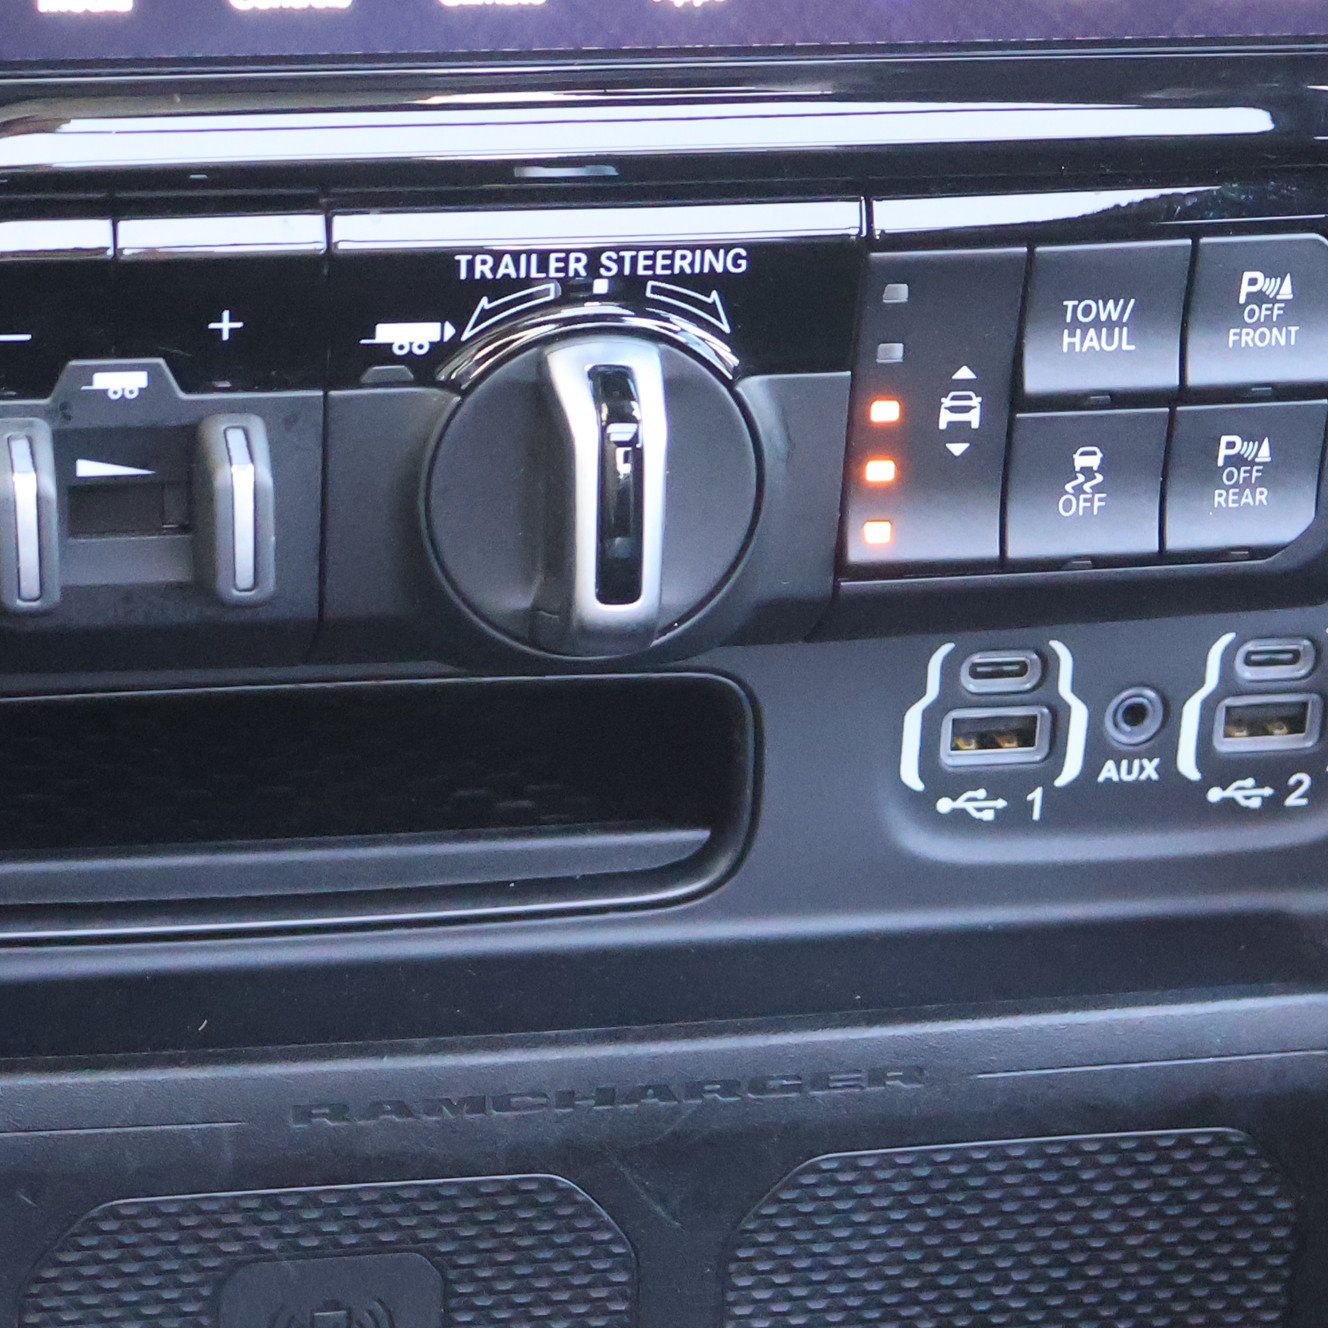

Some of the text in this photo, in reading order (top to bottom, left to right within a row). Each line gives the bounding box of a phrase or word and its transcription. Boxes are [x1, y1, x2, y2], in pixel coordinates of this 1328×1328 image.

[454, 248, 748, 280] TRAILER STEERING
[1062, 298, 1136, 323] TOW/
[1243, 303, 1285, 324] OFF
[1062, 327, 1136, 352] HAUL
[1228, 325, 1300, 348] FRONT
[1222, 466, 1264, 485] OFF
[1058, 493, 1107, 516] OFF
[1213, 487, 1269, 508] REAR
[1097, 757, 1161, 784] AUX
[1283, 773, 1312, 807] 2
[1025, 786, 1044, 820] 1
[289, 1065, 926, 1127] RAMCHARGER
